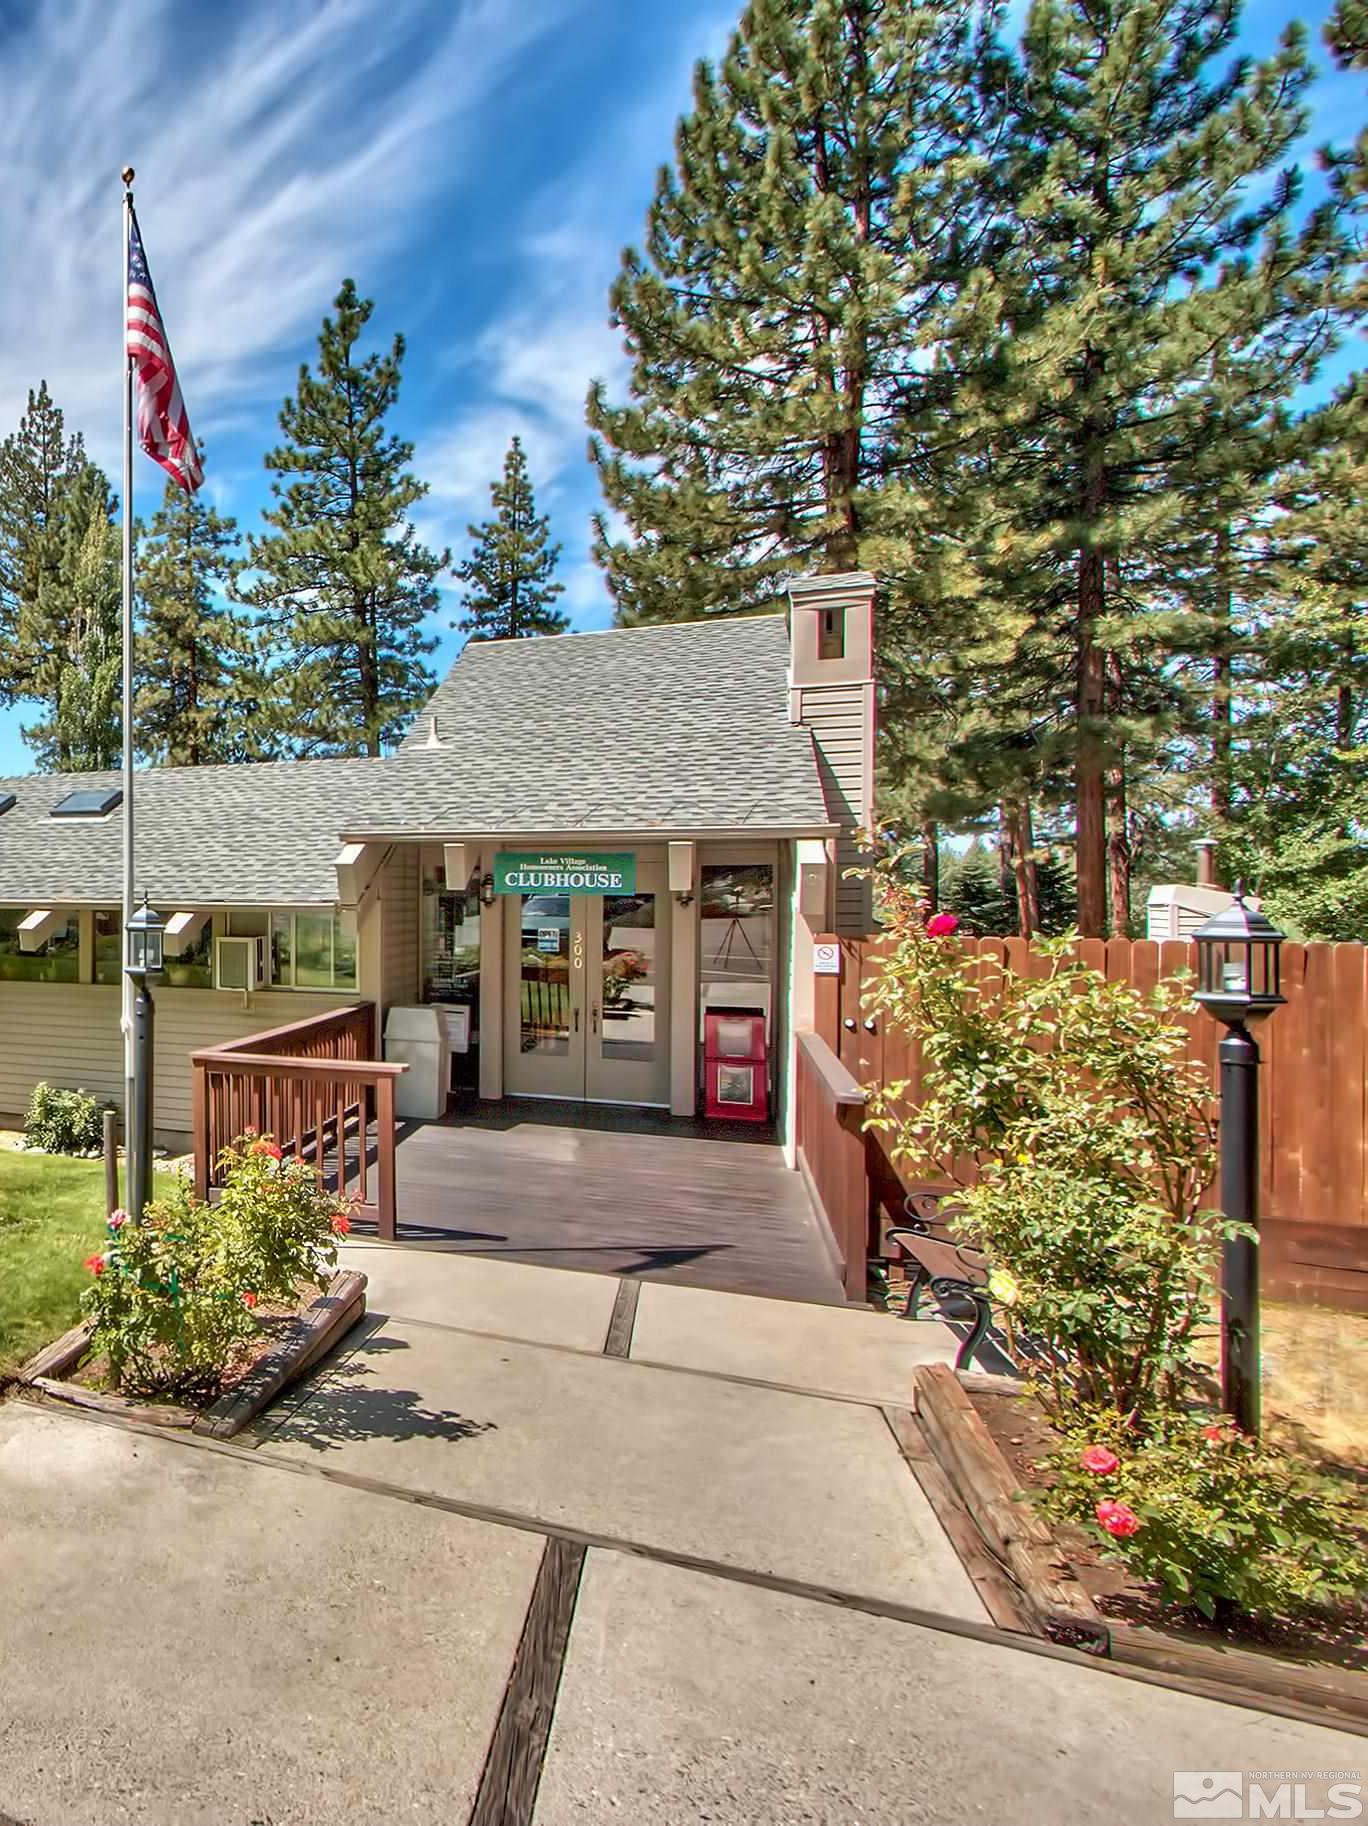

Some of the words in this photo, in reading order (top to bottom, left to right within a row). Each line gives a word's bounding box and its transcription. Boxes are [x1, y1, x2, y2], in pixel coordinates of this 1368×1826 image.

[540, 857, 558, 865] Lake
[560, 857, 586, 866] Village
[566, 864, 608, 872] Association
[505, 872, 622, 888] CLUBHOUSE
[574, 931, 582, 968] 300
